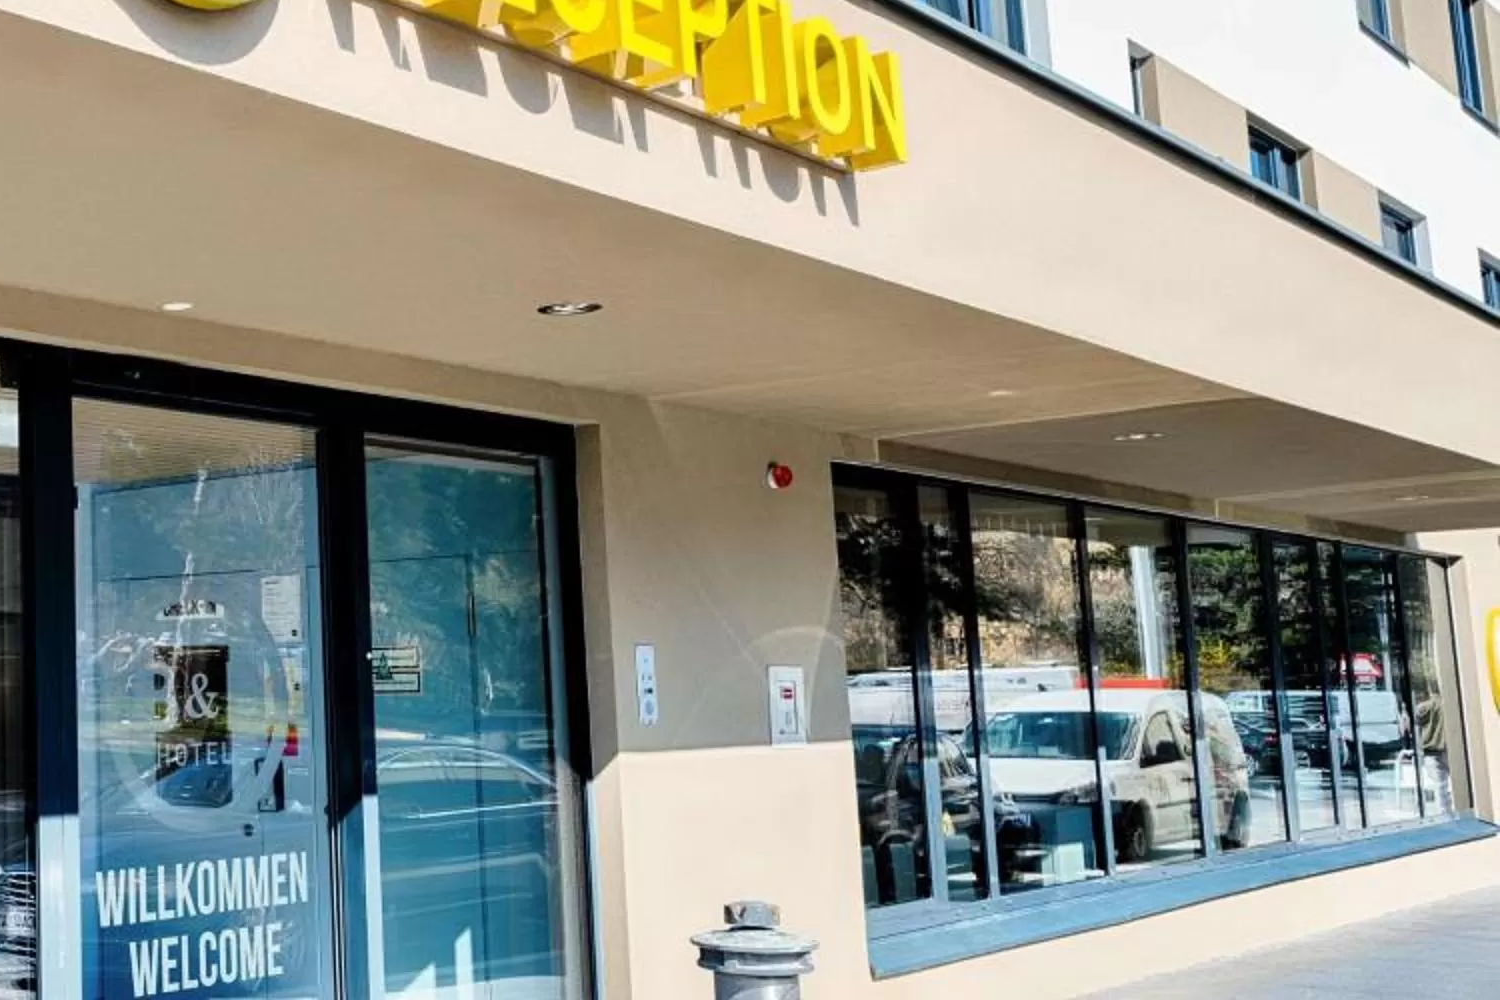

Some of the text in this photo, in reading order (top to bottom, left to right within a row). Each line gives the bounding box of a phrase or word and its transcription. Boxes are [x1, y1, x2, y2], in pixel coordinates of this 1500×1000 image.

[156, 740, 236, 768] HOTEL
[96, 851, 308, 928] WILLKOMMEN
[129, 921, 285, 998] WELCOME
